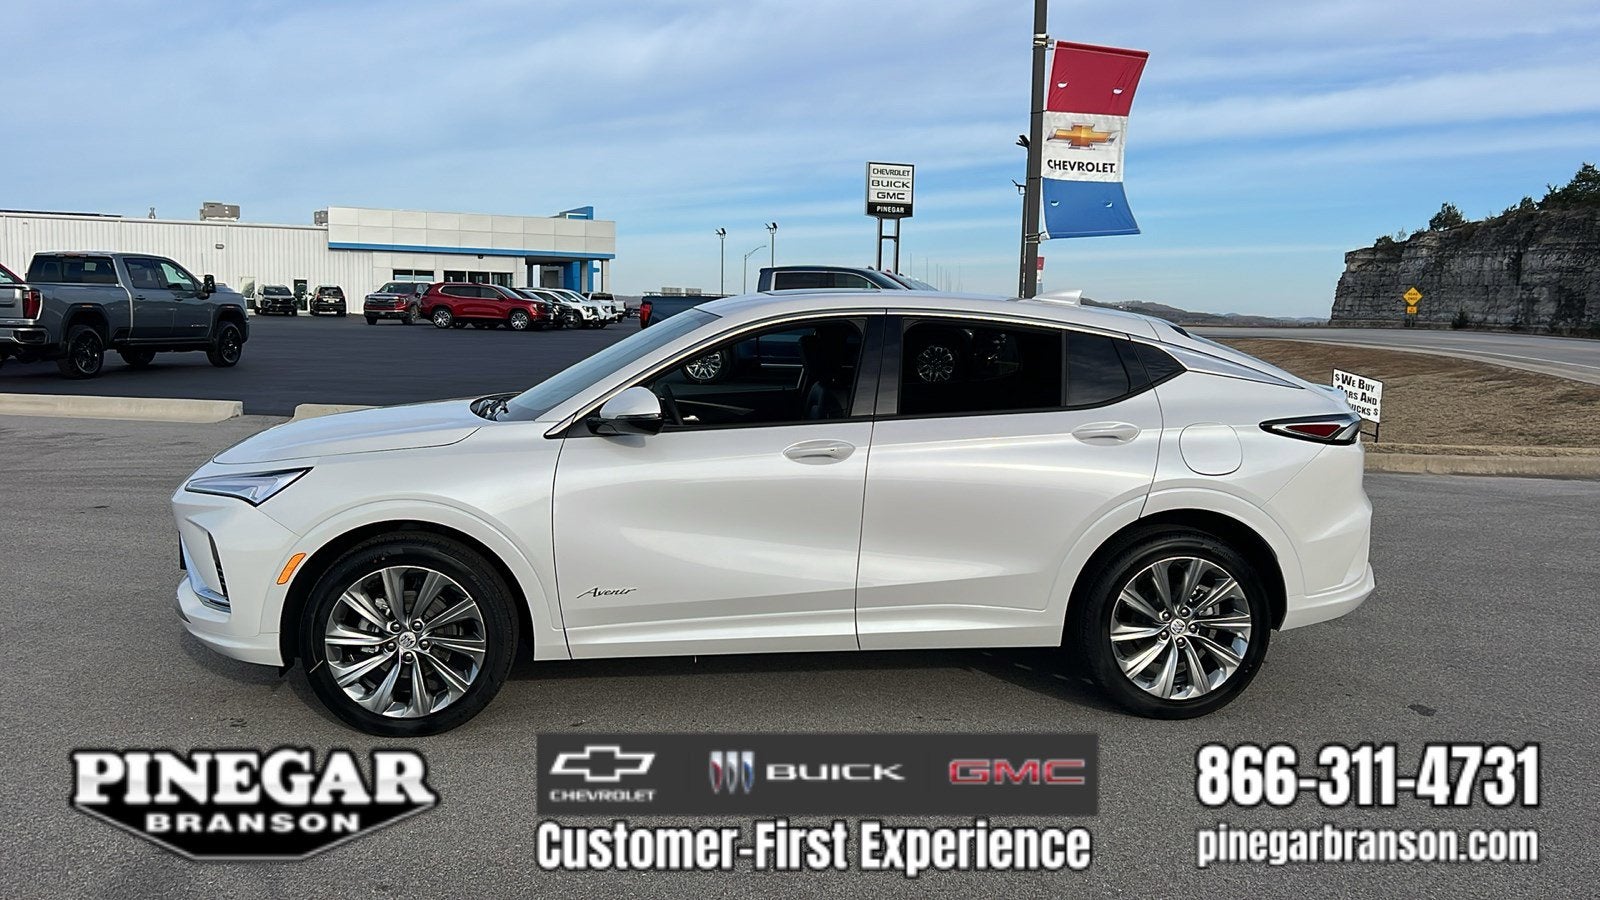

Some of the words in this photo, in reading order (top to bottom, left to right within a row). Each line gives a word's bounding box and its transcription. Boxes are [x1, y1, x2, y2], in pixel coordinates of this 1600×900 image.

[872, 168, 910, 176] CHEVROLET
[872, 180, 910, 188] BUICK
[877, 192, 905, 200] GMC
[577, 587, 636, 598] Avenir
